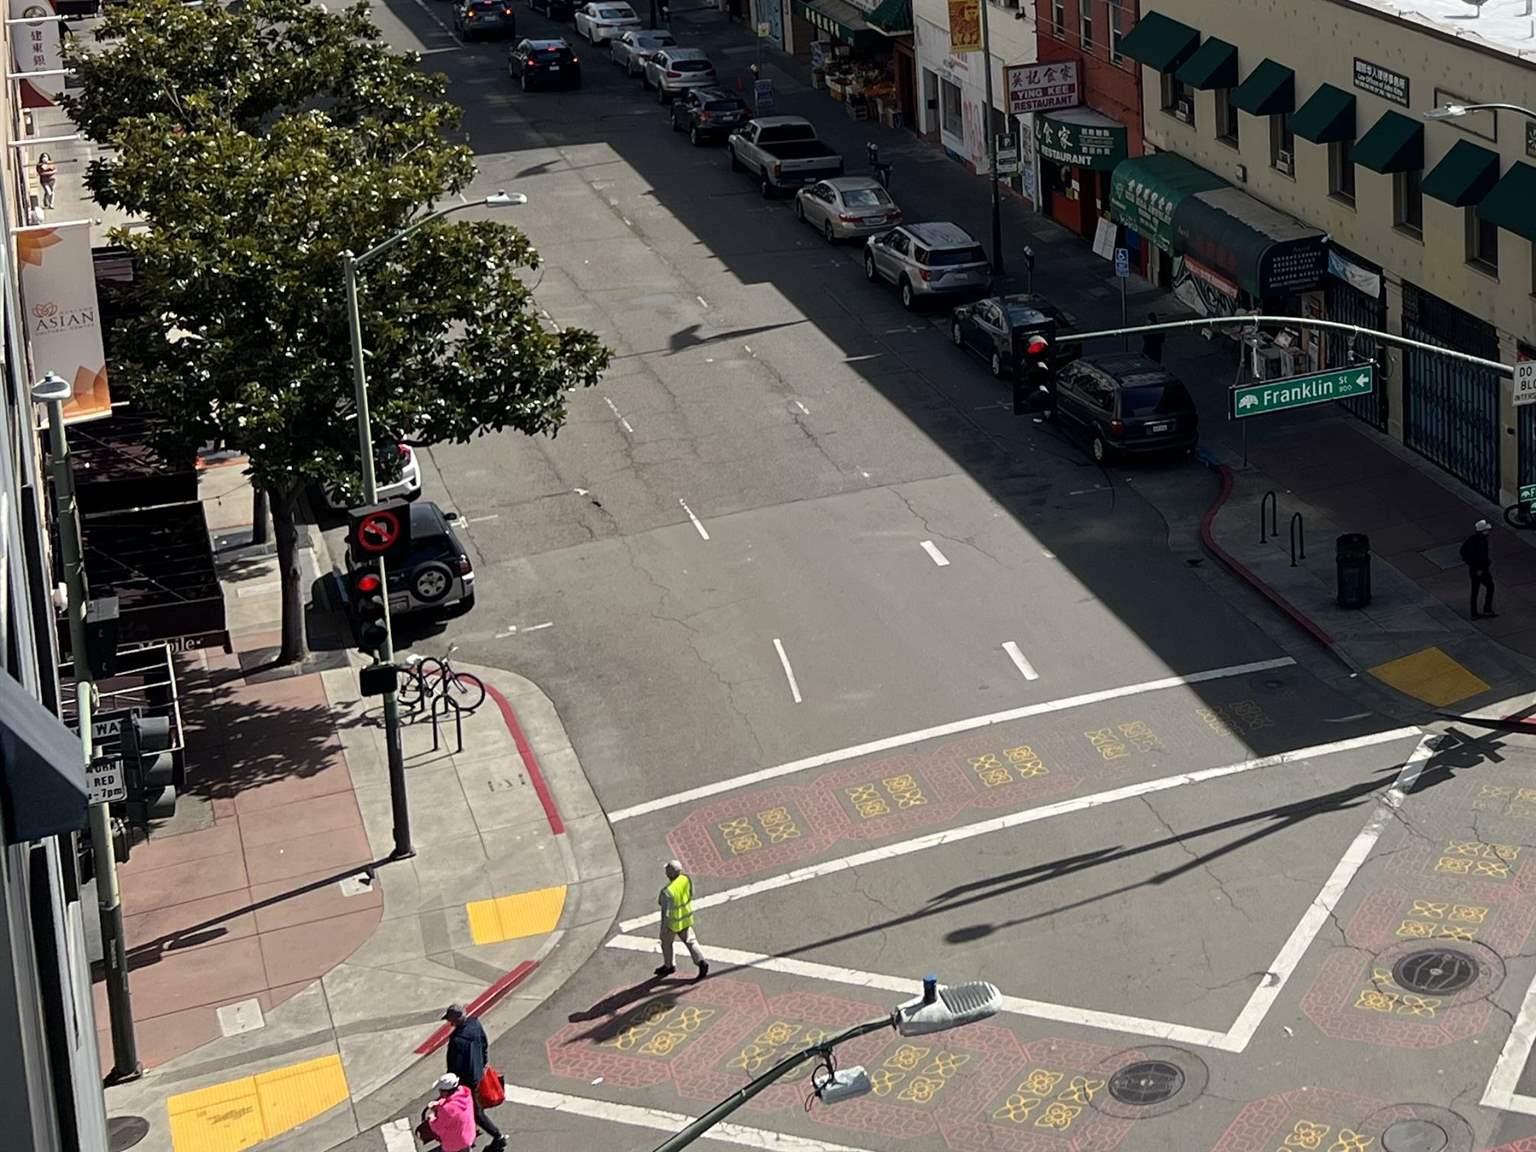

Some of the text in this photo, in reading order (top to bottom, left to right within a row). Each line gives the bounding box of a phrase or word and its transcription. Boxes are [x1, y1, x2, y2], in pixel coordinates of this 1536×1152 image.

[1017, 86, 1070, 101] YING KEE
[1014, 95, 1073, 111] RESTAURANT
[36, 311, 93, 331] ASIAN
[1338, 375, 1348, 384] St
[1520, 366, 1533, 378] DO
[1263, 380, 1333, 406] Franklin
[96, 721, 121, 736] WA
[94, 775, 115, 787] RED
